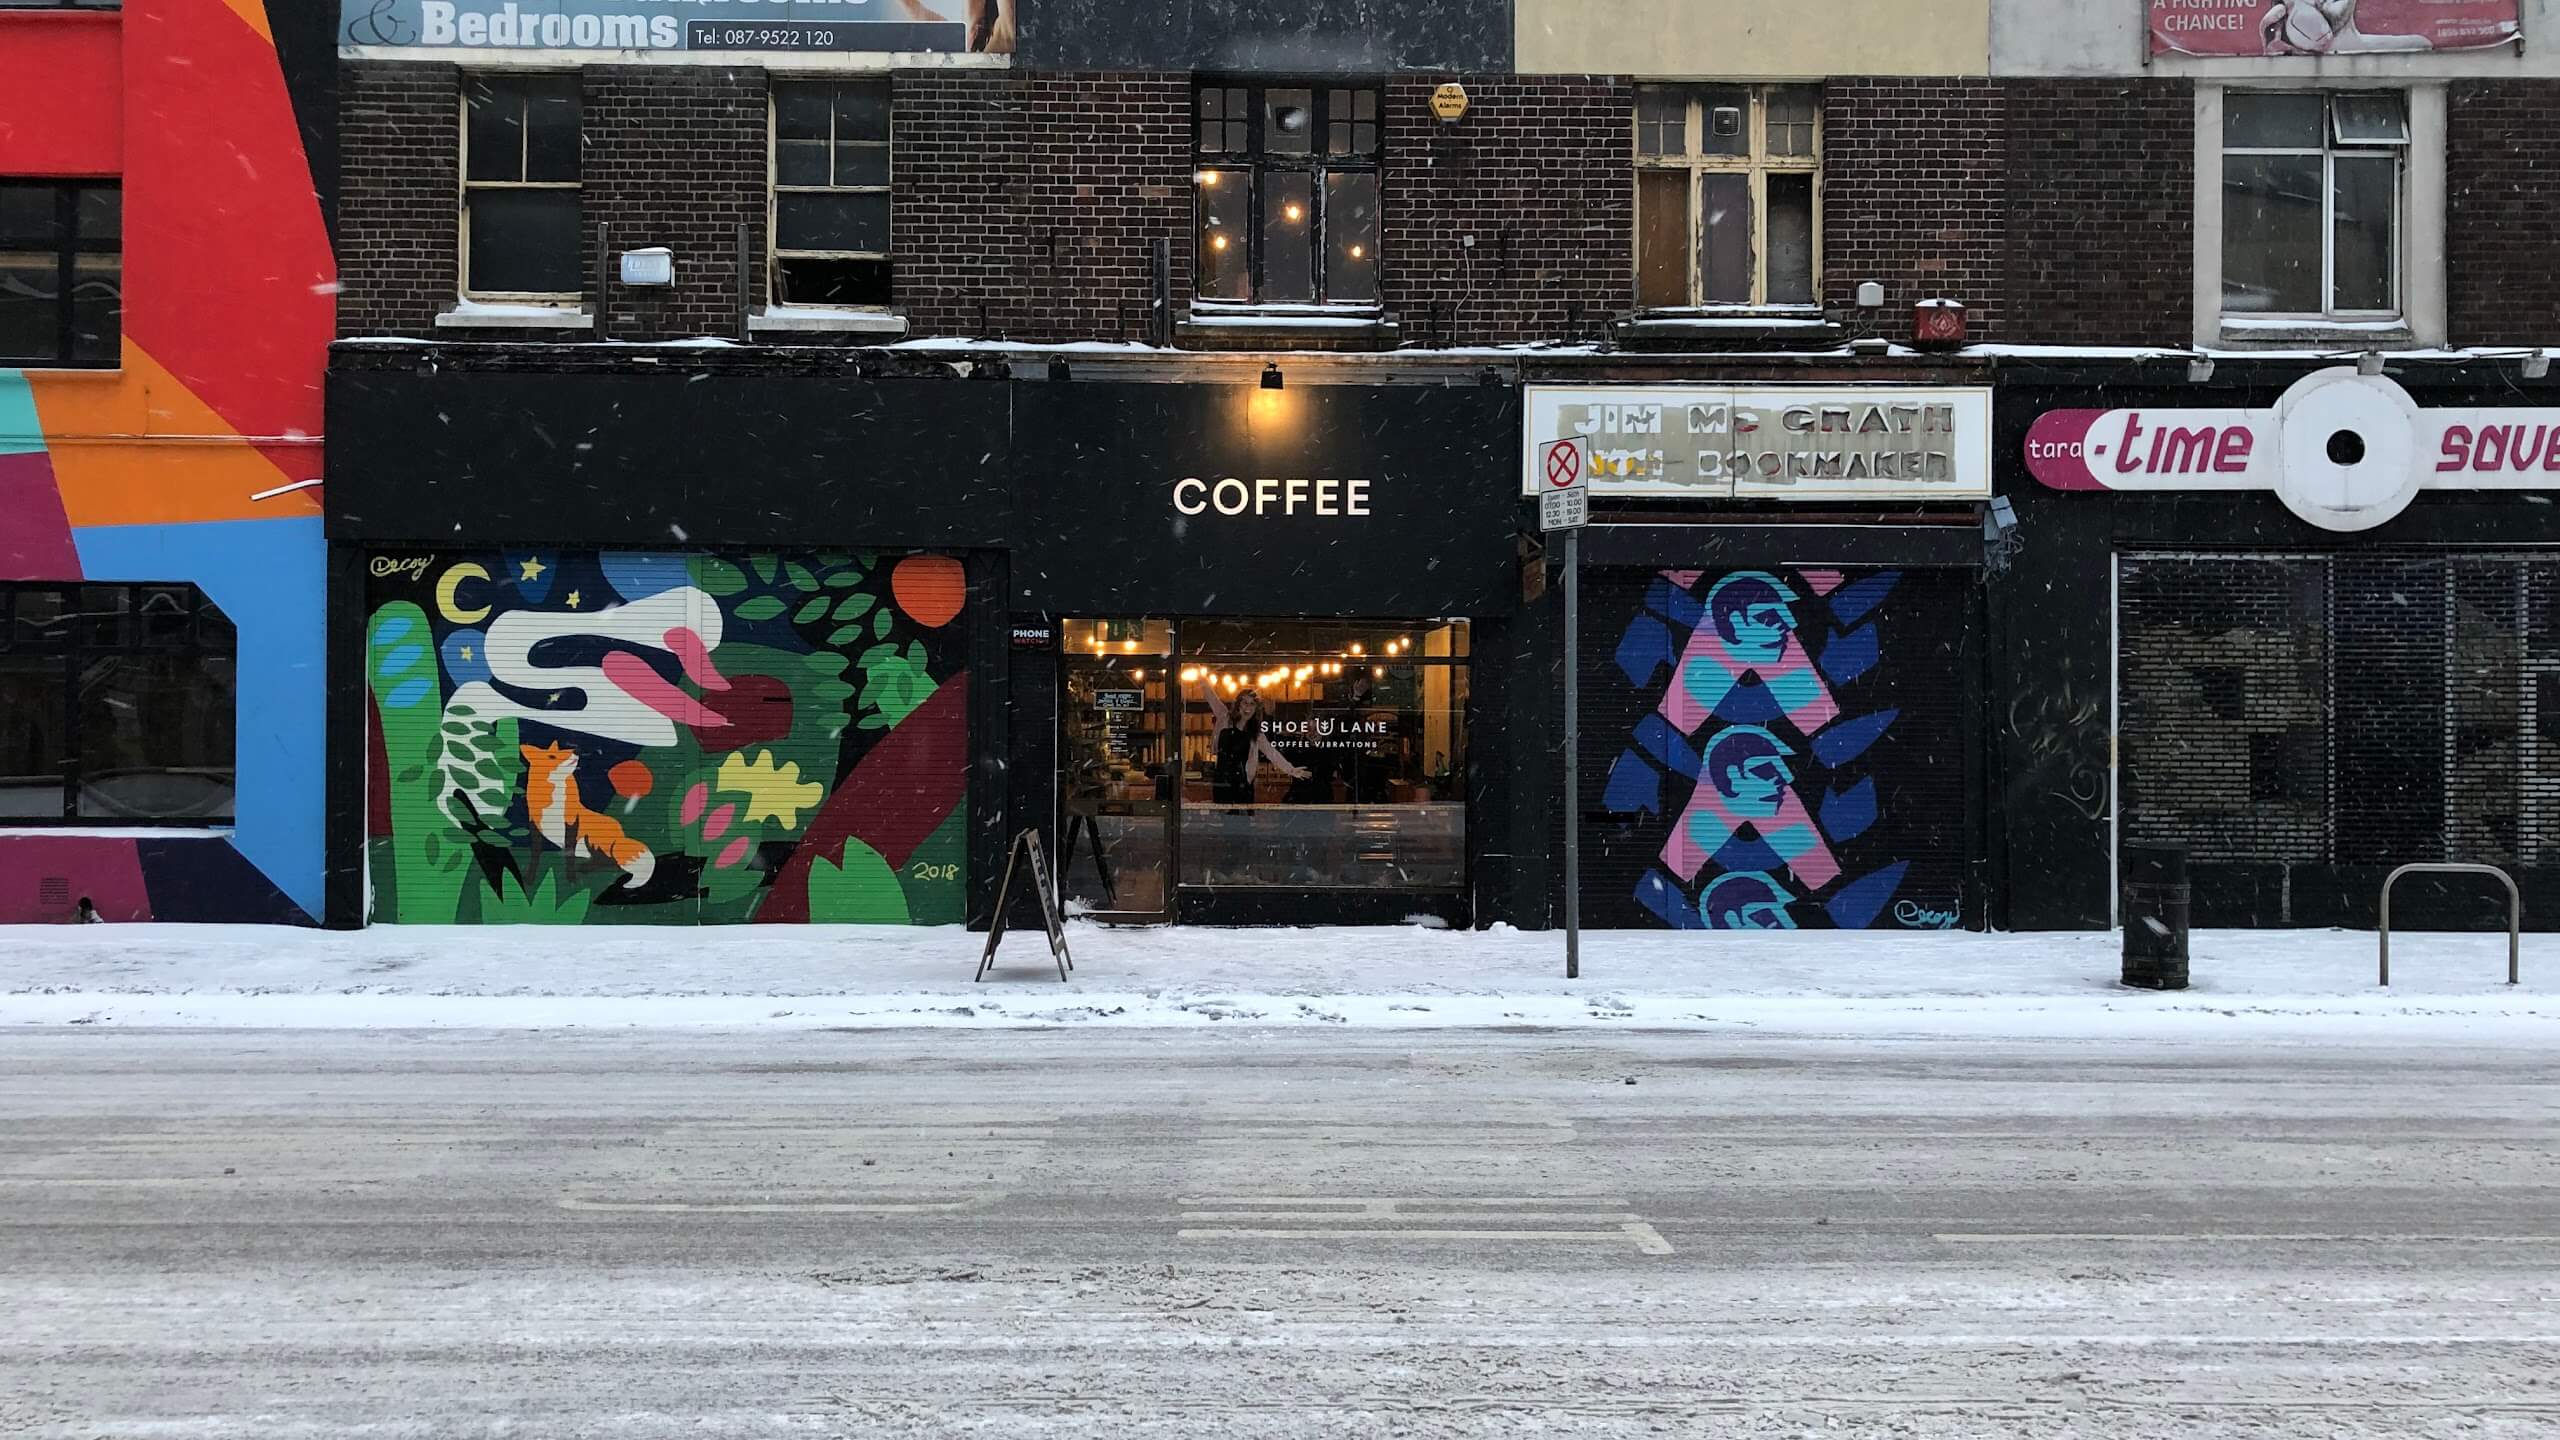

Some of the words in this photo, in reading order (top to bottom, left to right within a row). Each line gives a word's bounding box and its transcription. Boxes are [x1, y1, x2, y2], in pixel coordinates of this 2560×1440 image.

[421, 1, 678, 48] Bedrooms
[2164, 14, 2244, 31] CHANCE!
[696, 29, 721, 46] Tel:
[725, 29, 800, 46] 087-9522
[805, 30, 834, 46] 120
[1438, 101, 1462, 109] Alarms
[1574, 405, 1662, 434] JIM
[2029, 439, 2082, 459] tara
[1173, 478, 1371, 516] COFFEE
[1013, 629, 1050, 638] PHONE
[1260, 721, 1309, 733] SHOE
[1341, 721, 1387, 733] LANE
[911, 861, 960, 881] 2018
